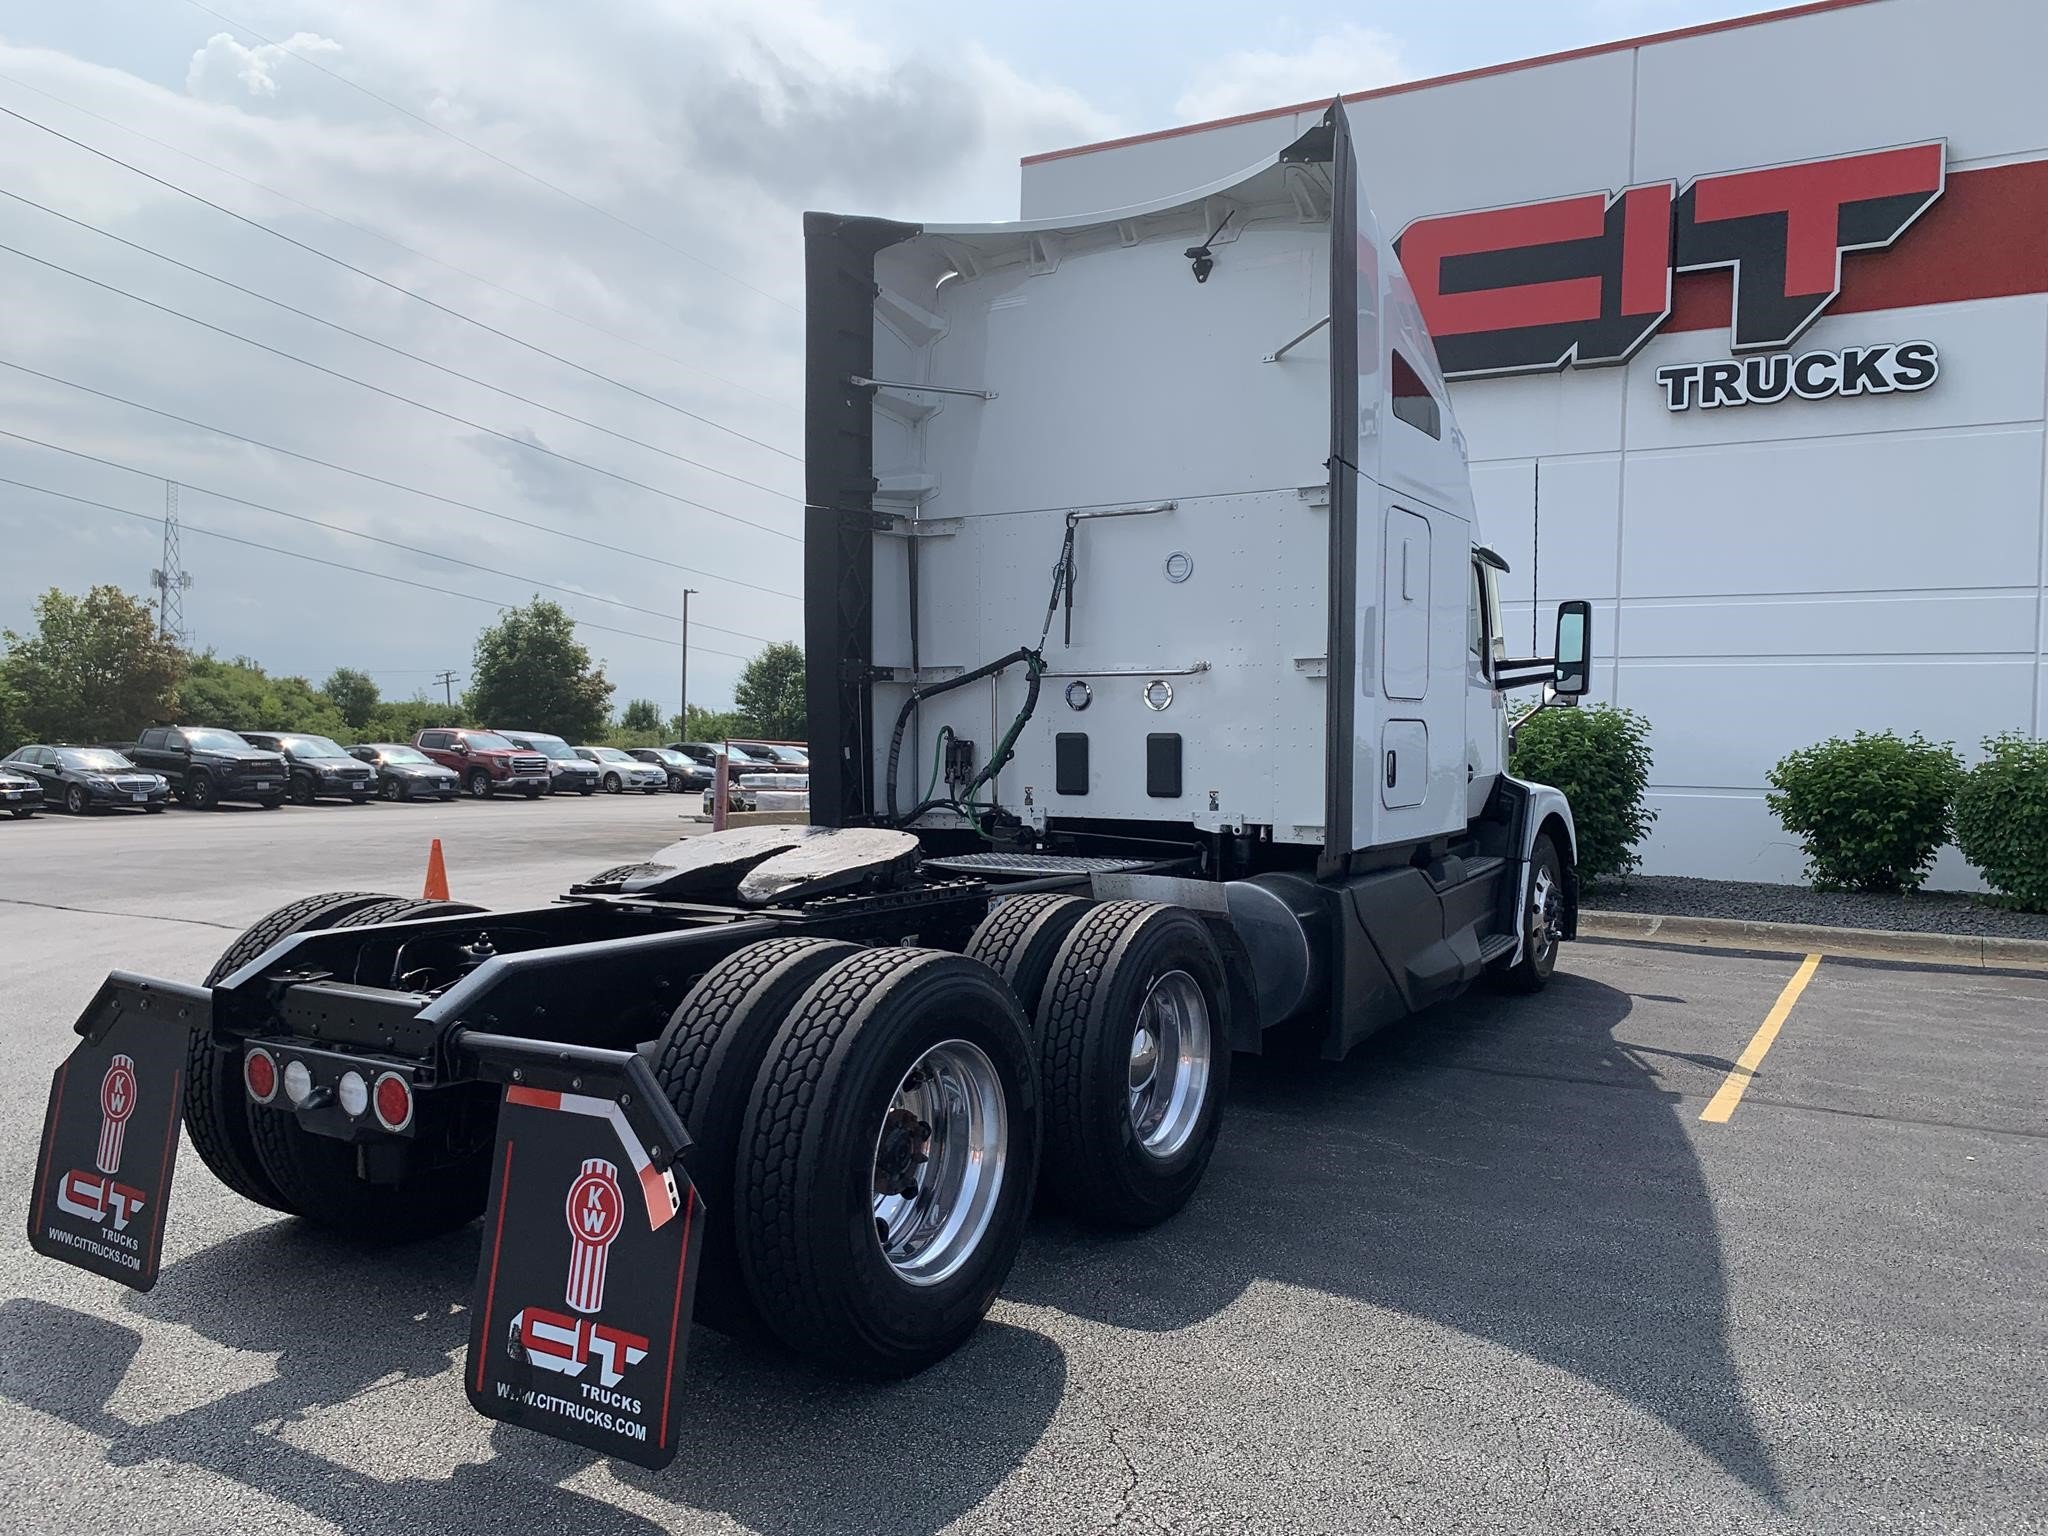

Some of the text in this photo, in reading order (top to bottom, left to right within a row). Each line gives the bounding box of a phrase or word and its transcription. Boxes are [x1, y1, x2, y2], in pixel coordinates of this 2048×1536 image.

[1391, 137, 1947, 382] CIT
[1657, 341, 1939, 410] TRUCKS
[57, 1168, 146, 1231] CIT
[48, 1226, 141, 1271] WWW.CITTRUCKS.COM
[101, 1227, 139, 1251] TRUCKS
[507, 1306, 649, 1388] CIT
[496, 1381, 647, 1442] WW.CITTRUCKS.COM
[580, 1383, 642, 1415] TRUCKS
